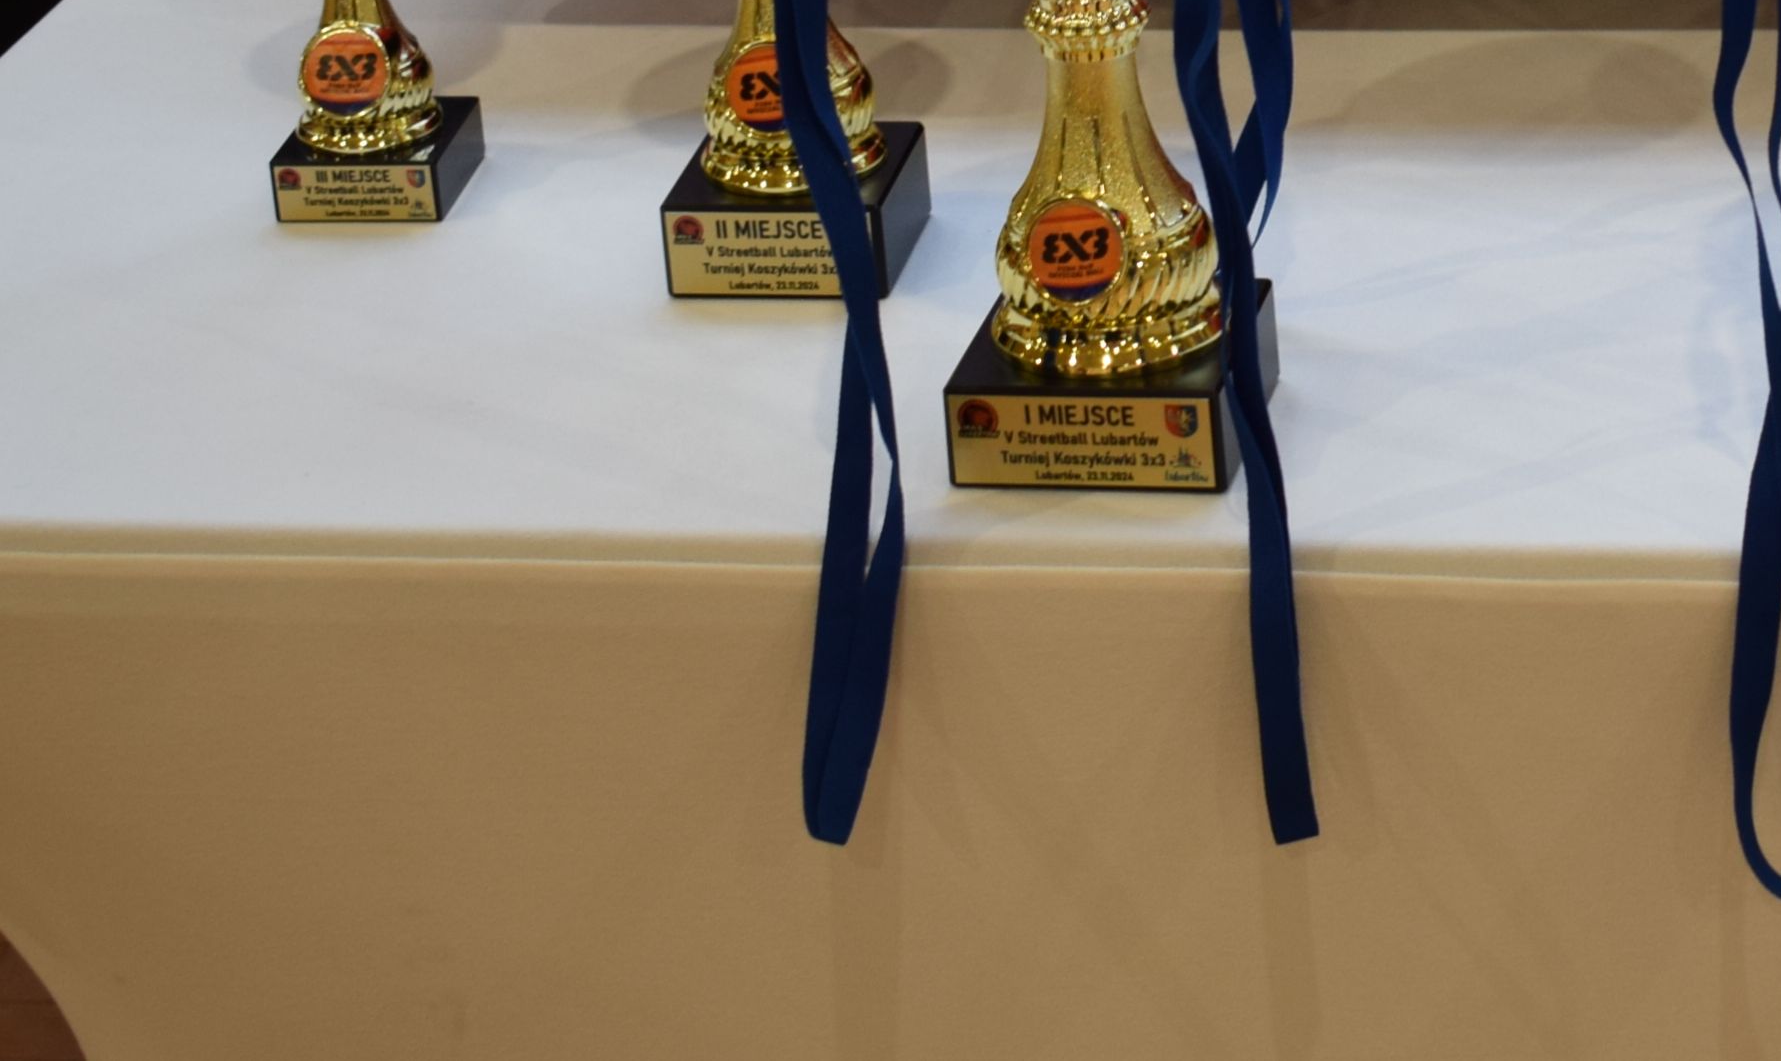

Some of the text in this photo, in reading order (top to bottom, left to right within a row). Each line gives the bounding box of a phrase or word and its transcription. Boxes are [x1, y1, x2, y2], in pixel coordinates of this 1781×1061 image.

[332, 170, 391, 183] MIEJSCE
[715, 220, 727, 239] II
[735, 220, 824, 239] MIEJSCE
[706, 247, 715, 258] V
[717, 246, 777, 258] Streetball
[703, 263, 745, 277] Turniej
[749, 262, 818, 277] Koszykówki
[1024, 404, 1135, 427] I MIEJSCE
[1004, 430, 1014, 444] V
[1018, 431, 1088, 445] Streetball
[1092, 431, 1159, 447] Lubartów
[1001, 450, 1166, 468] Turniej Koszykówki 3x3
